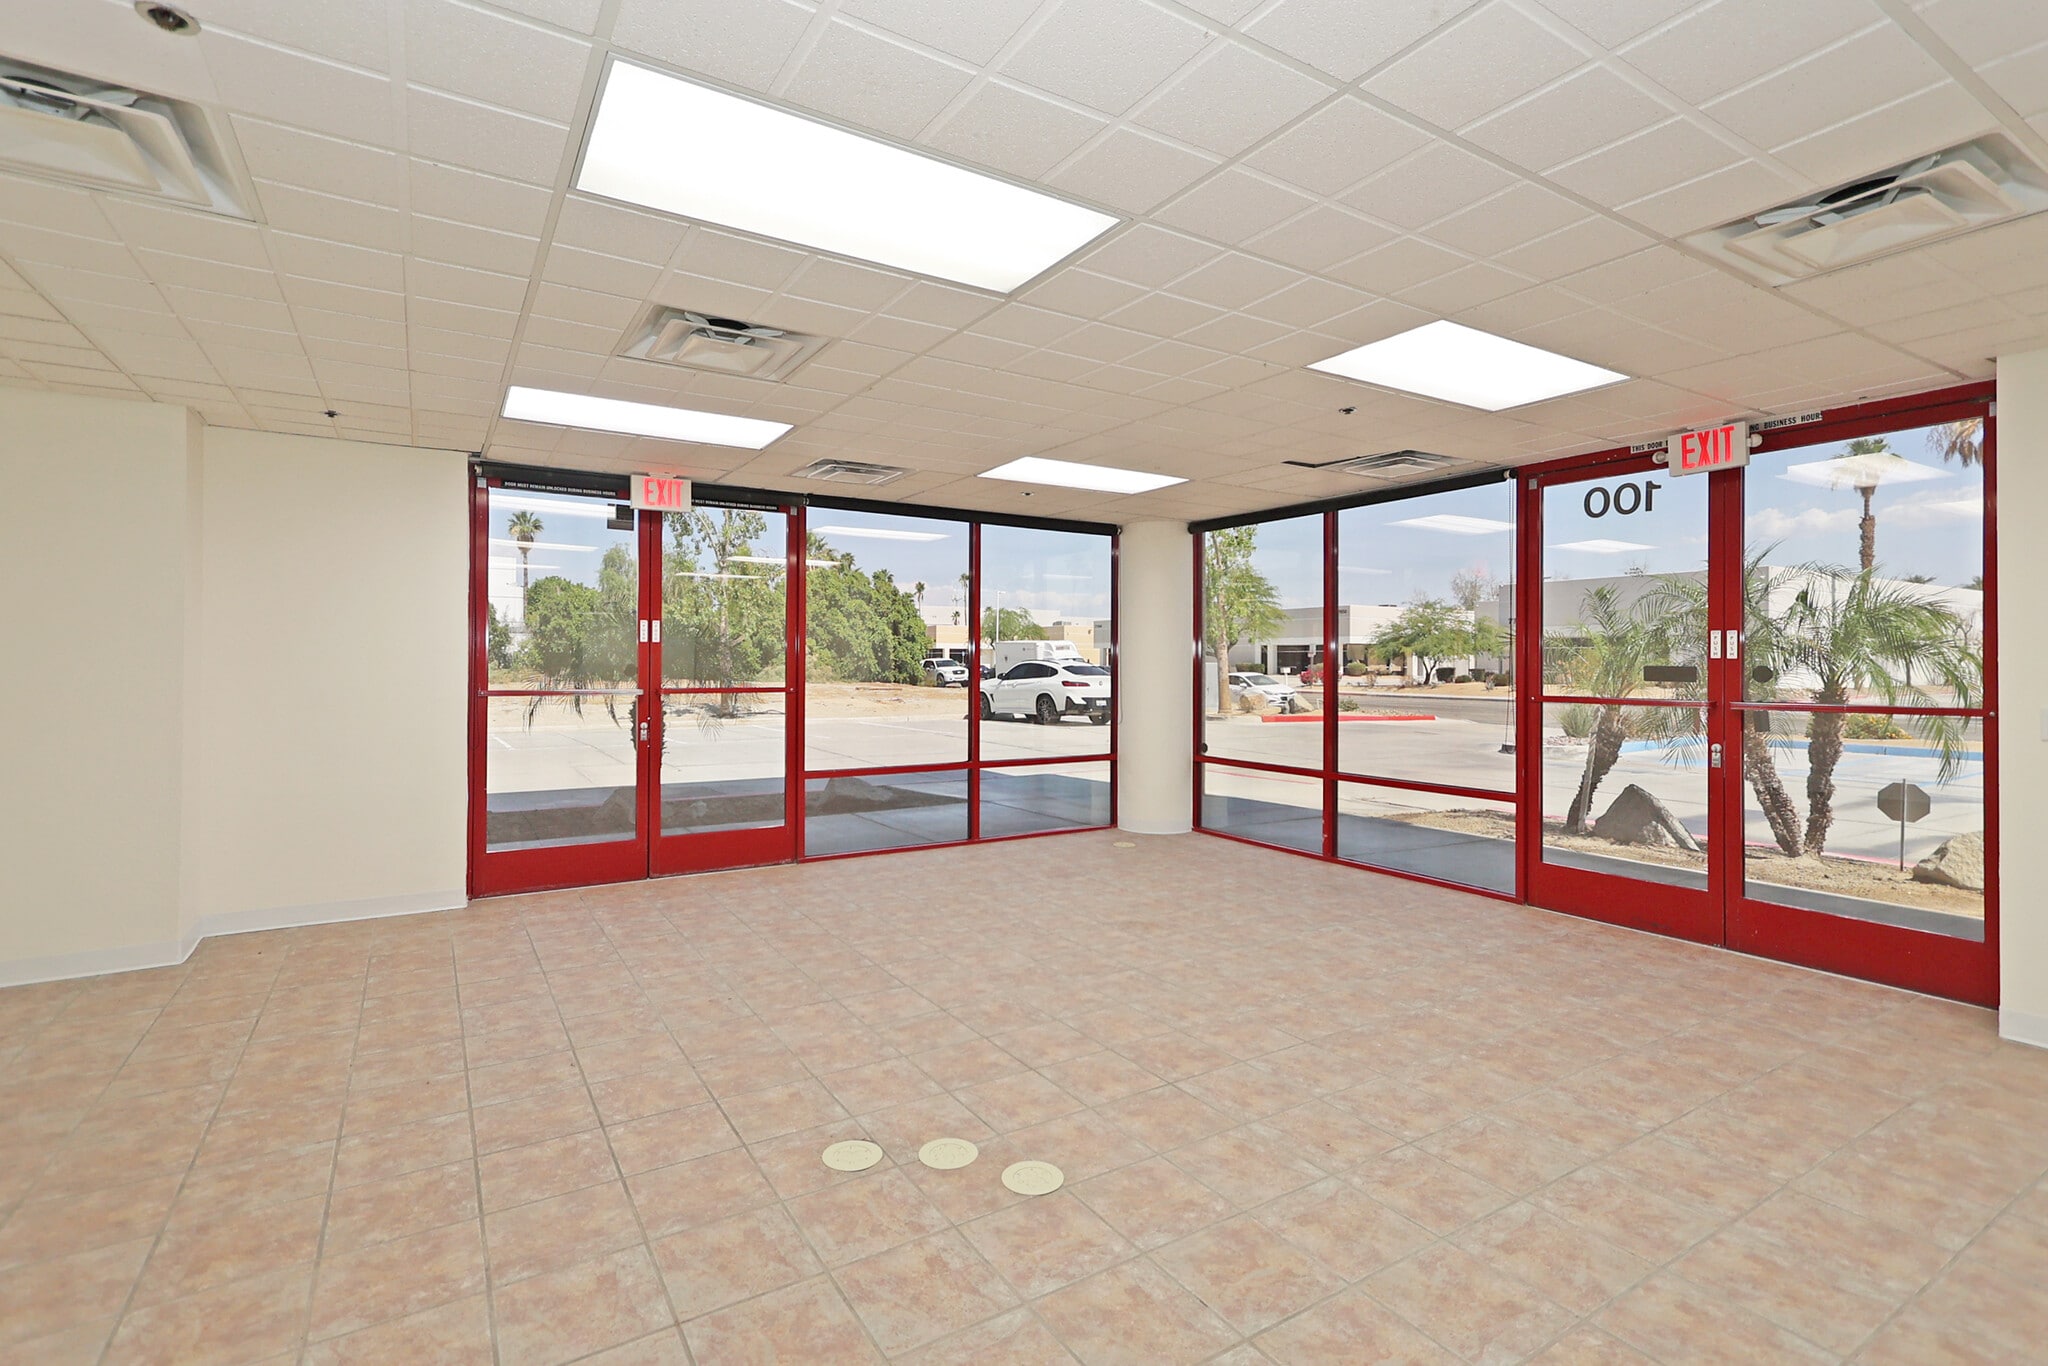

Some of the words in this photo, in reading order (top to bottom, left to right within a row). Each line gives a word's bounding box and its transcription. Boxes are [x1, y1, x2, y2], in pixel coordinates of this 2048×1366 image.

[1763, 417, 1797, 429] BUSINESS
[1632, 444, 1645, 452] THIS
[1647, 440, 1663, 449] DOOR
[1681, 425, 1735, 470] EXIT
[642, 477, 684, 508] EXIT
